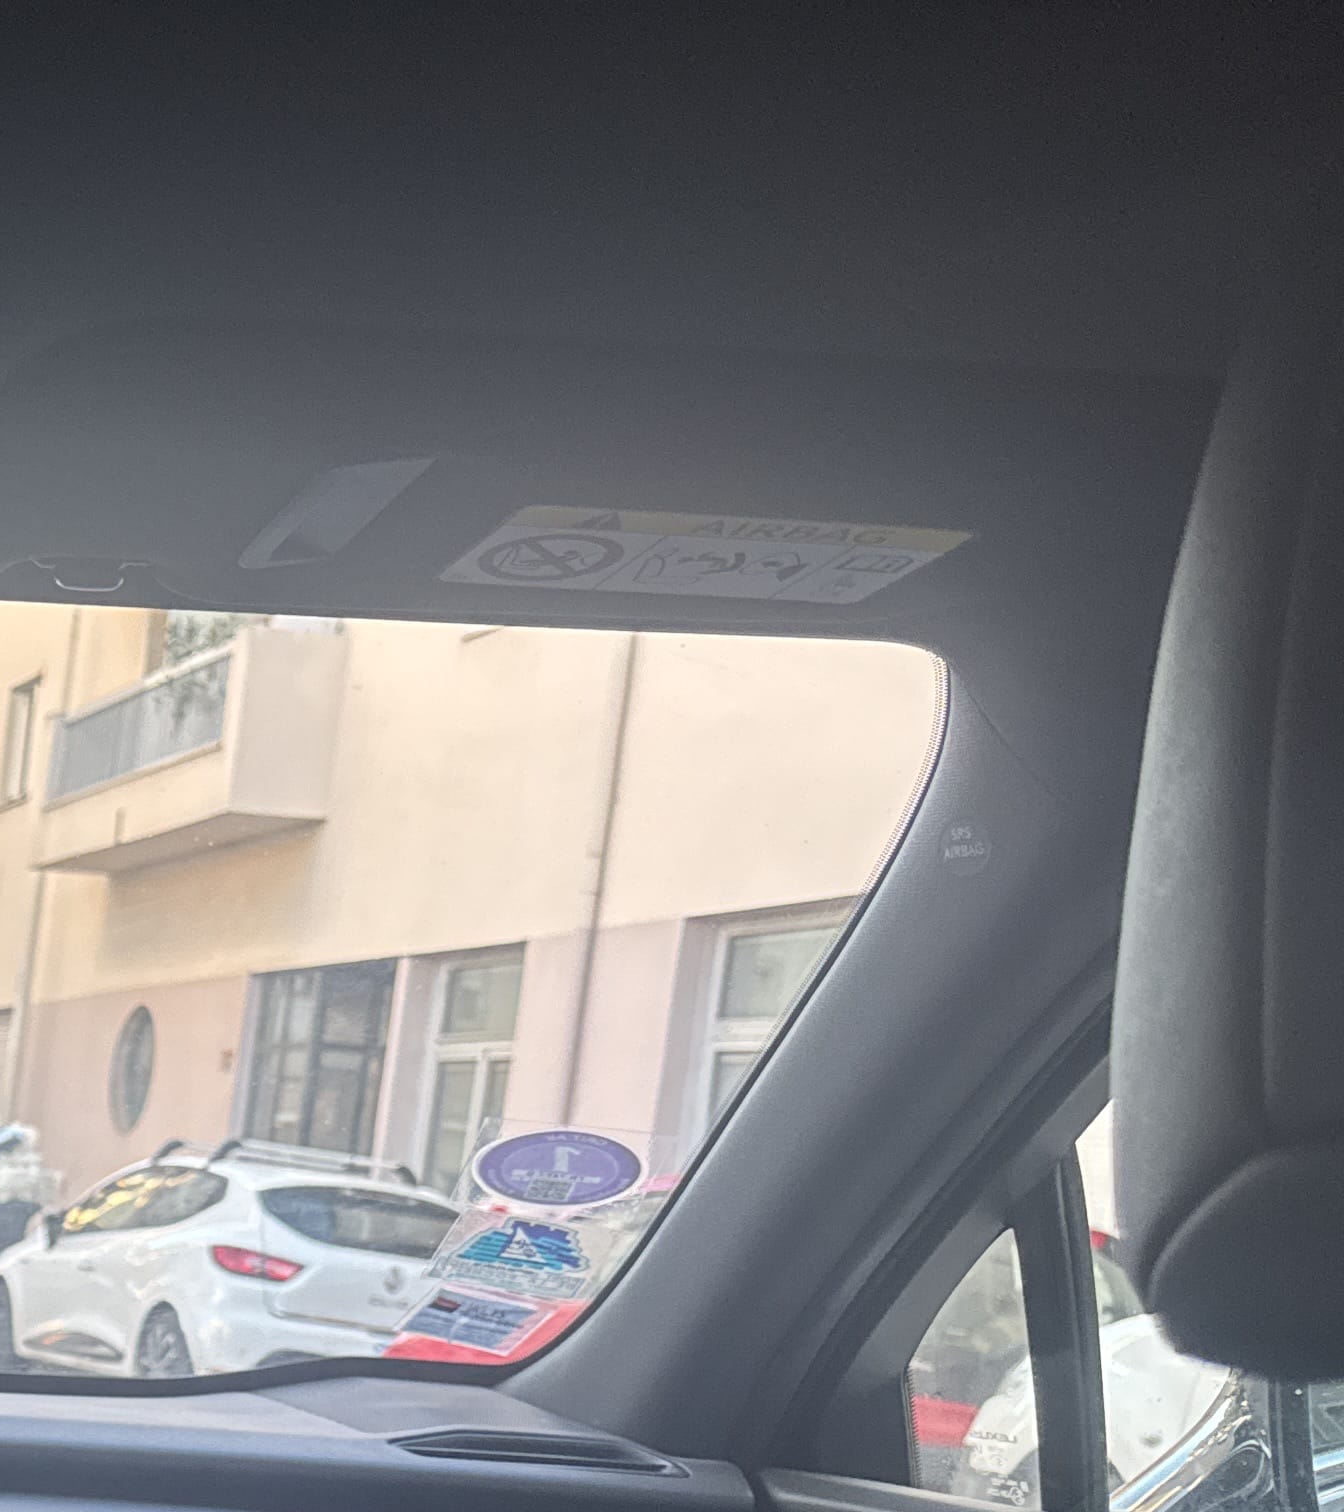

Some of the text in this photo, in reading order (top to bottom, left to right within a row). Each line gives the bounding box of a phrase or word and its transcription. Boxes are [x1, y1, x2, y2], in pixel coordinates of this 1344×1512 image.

[690, 518, 896, 546] AIRBAG
[950, 826, 972, 841] SRS
[944, 842, 985, 860] AIRBAG
